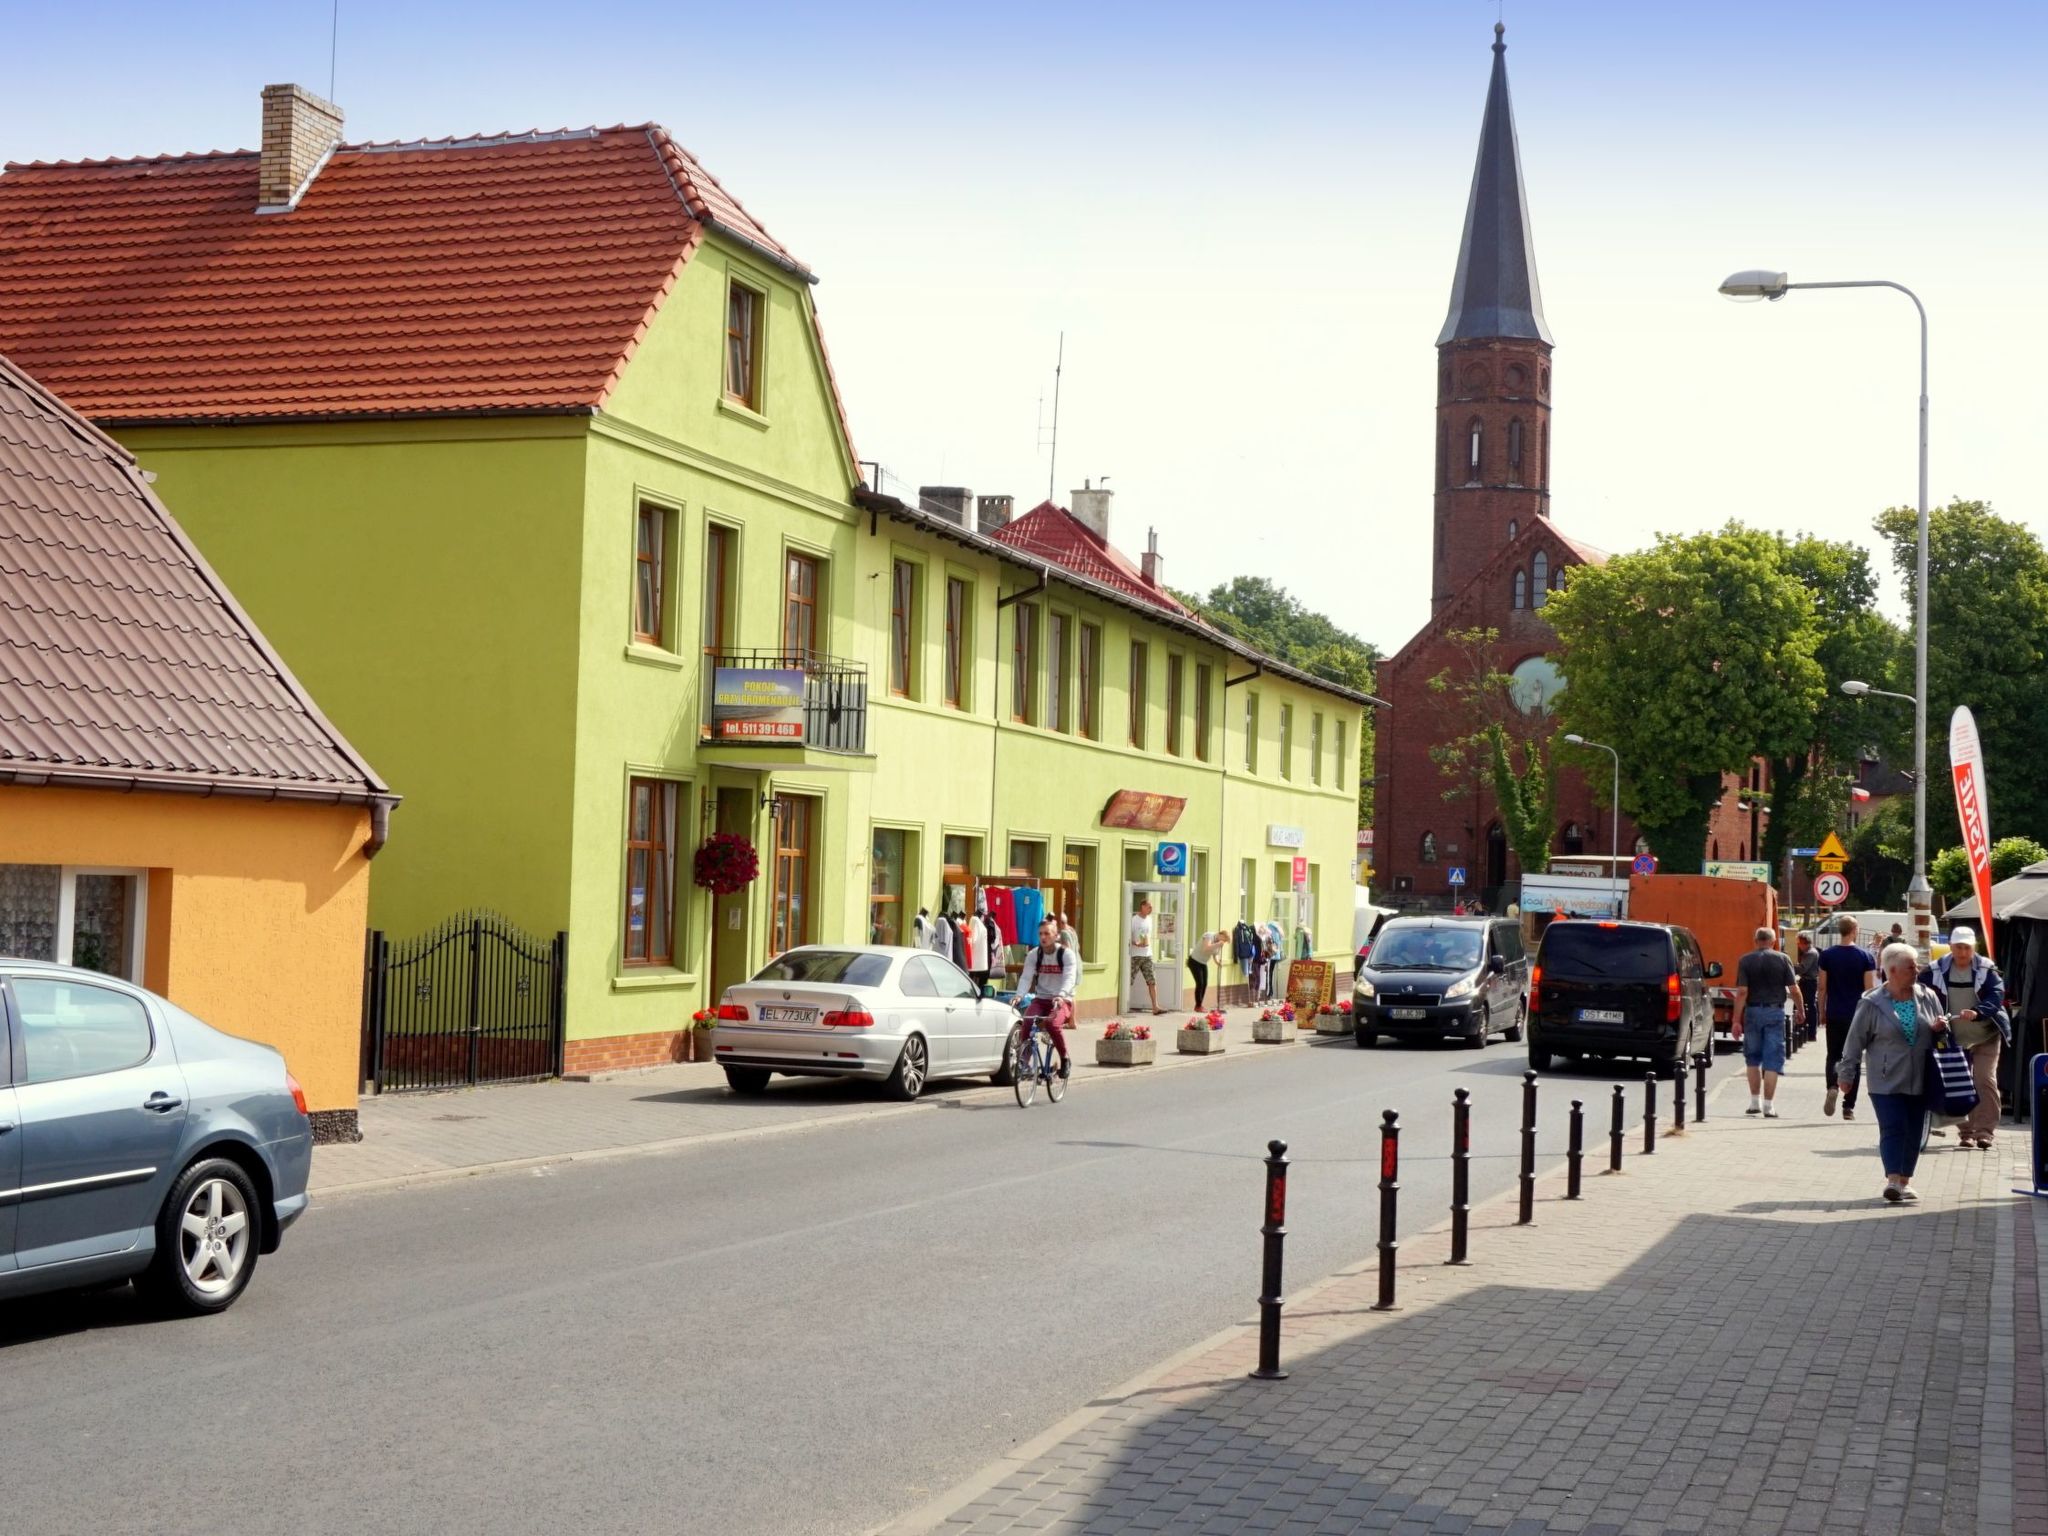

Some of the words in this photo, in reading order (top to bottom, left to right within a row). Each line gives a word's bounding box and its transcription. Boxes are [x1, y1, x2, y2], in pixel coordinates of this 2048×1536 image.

[725, 722, 741, 734] tel.
[742, 723, 758, 735] 511
[758, 724, 776, 735] 391
[1959, 767, 1989, 875] TYSKIE
[1161, 865, 1180, 873] pepsi
[1821, 880, 1843, 896] 20
[1292, 963, 1324, 972] DUO
[765, 1009, 779, 1020] EL
[782, 1009, 813, 1021] 773UK
